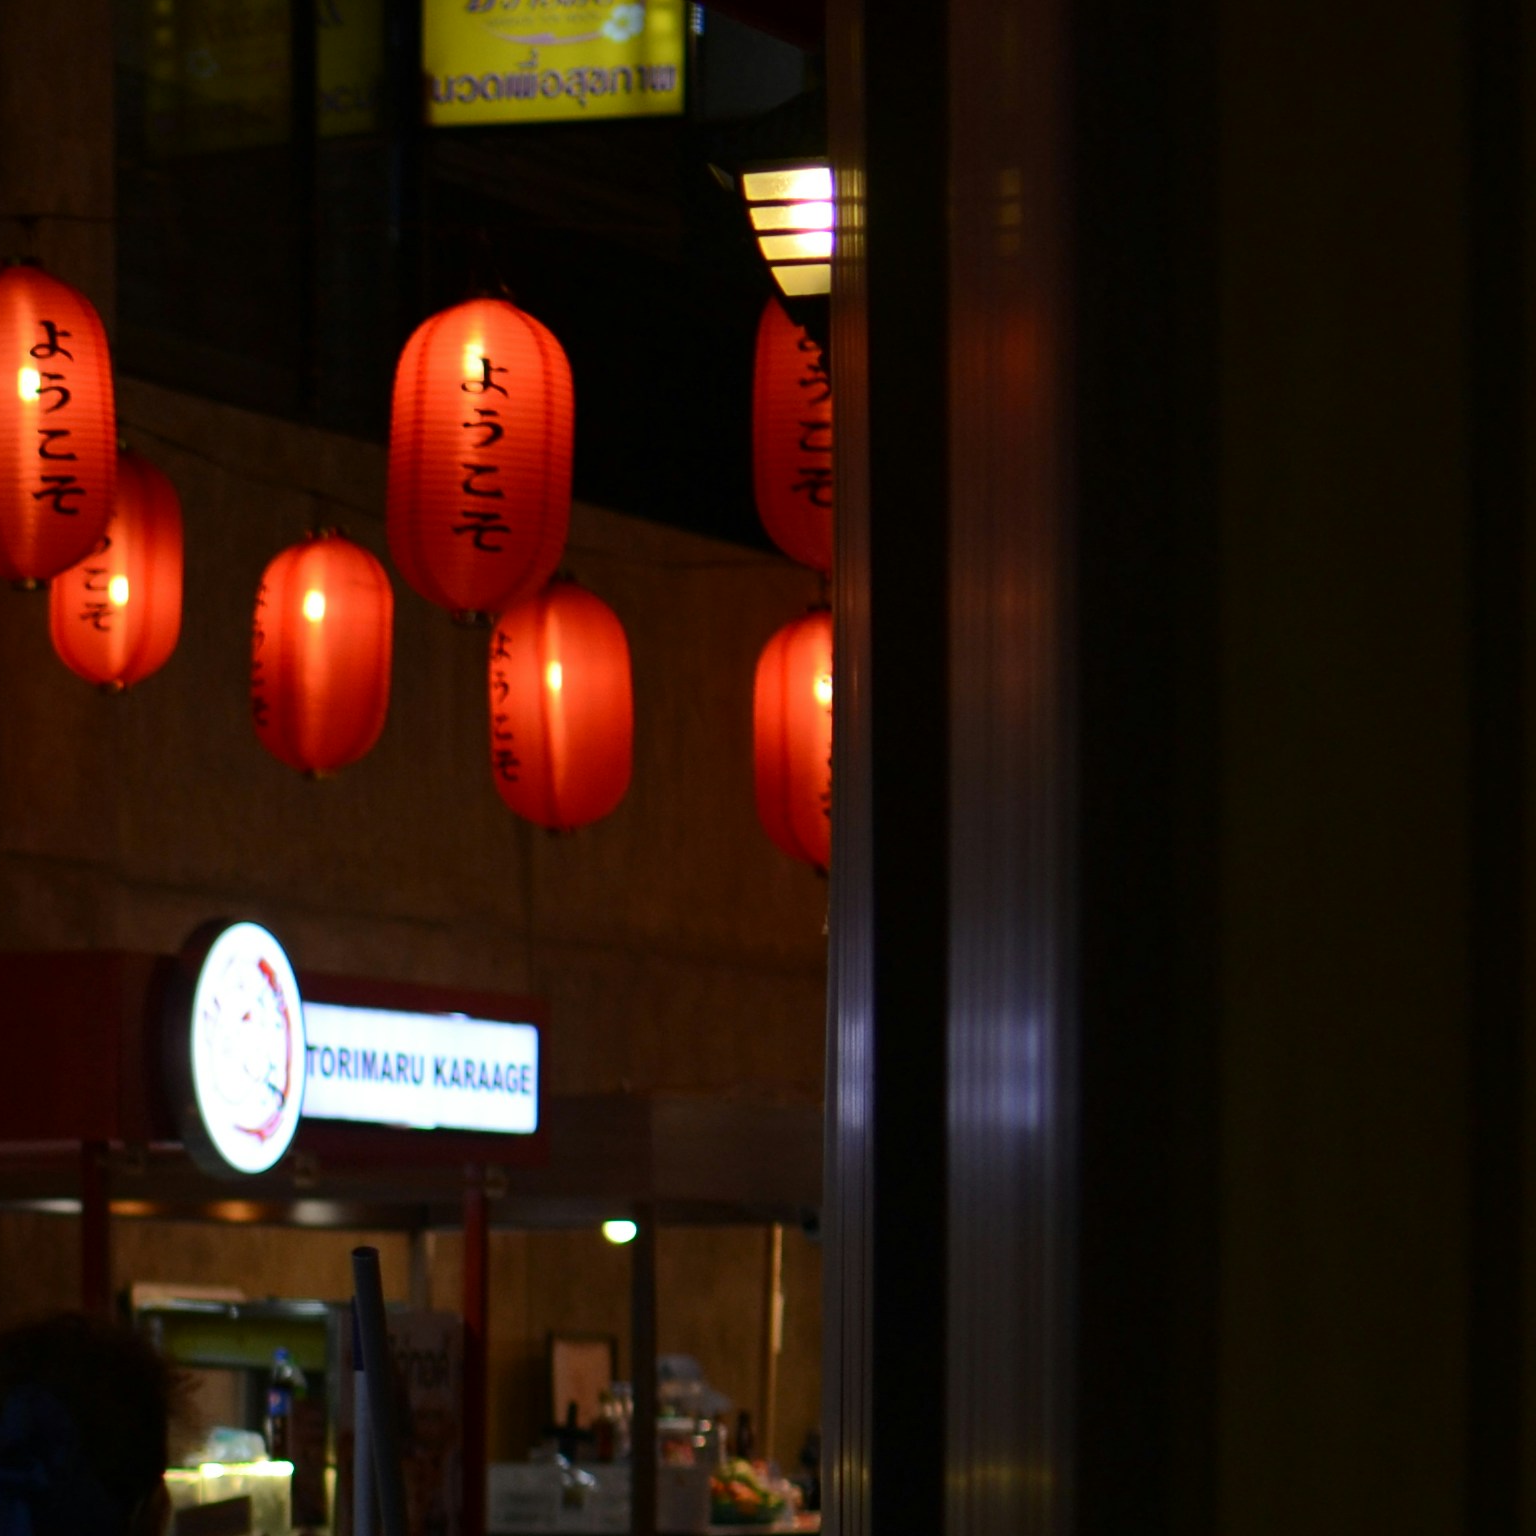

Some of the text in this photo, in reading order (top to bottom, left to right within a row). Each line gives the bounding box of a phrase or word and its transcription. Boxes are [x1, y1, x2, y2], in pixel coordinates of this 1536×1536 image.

[29, 320, 86, 517] ようこそ
[452, 356, 511, 555] ようこそ
[307, 1044, 532, 1096] TORIMARU KARAAGE
